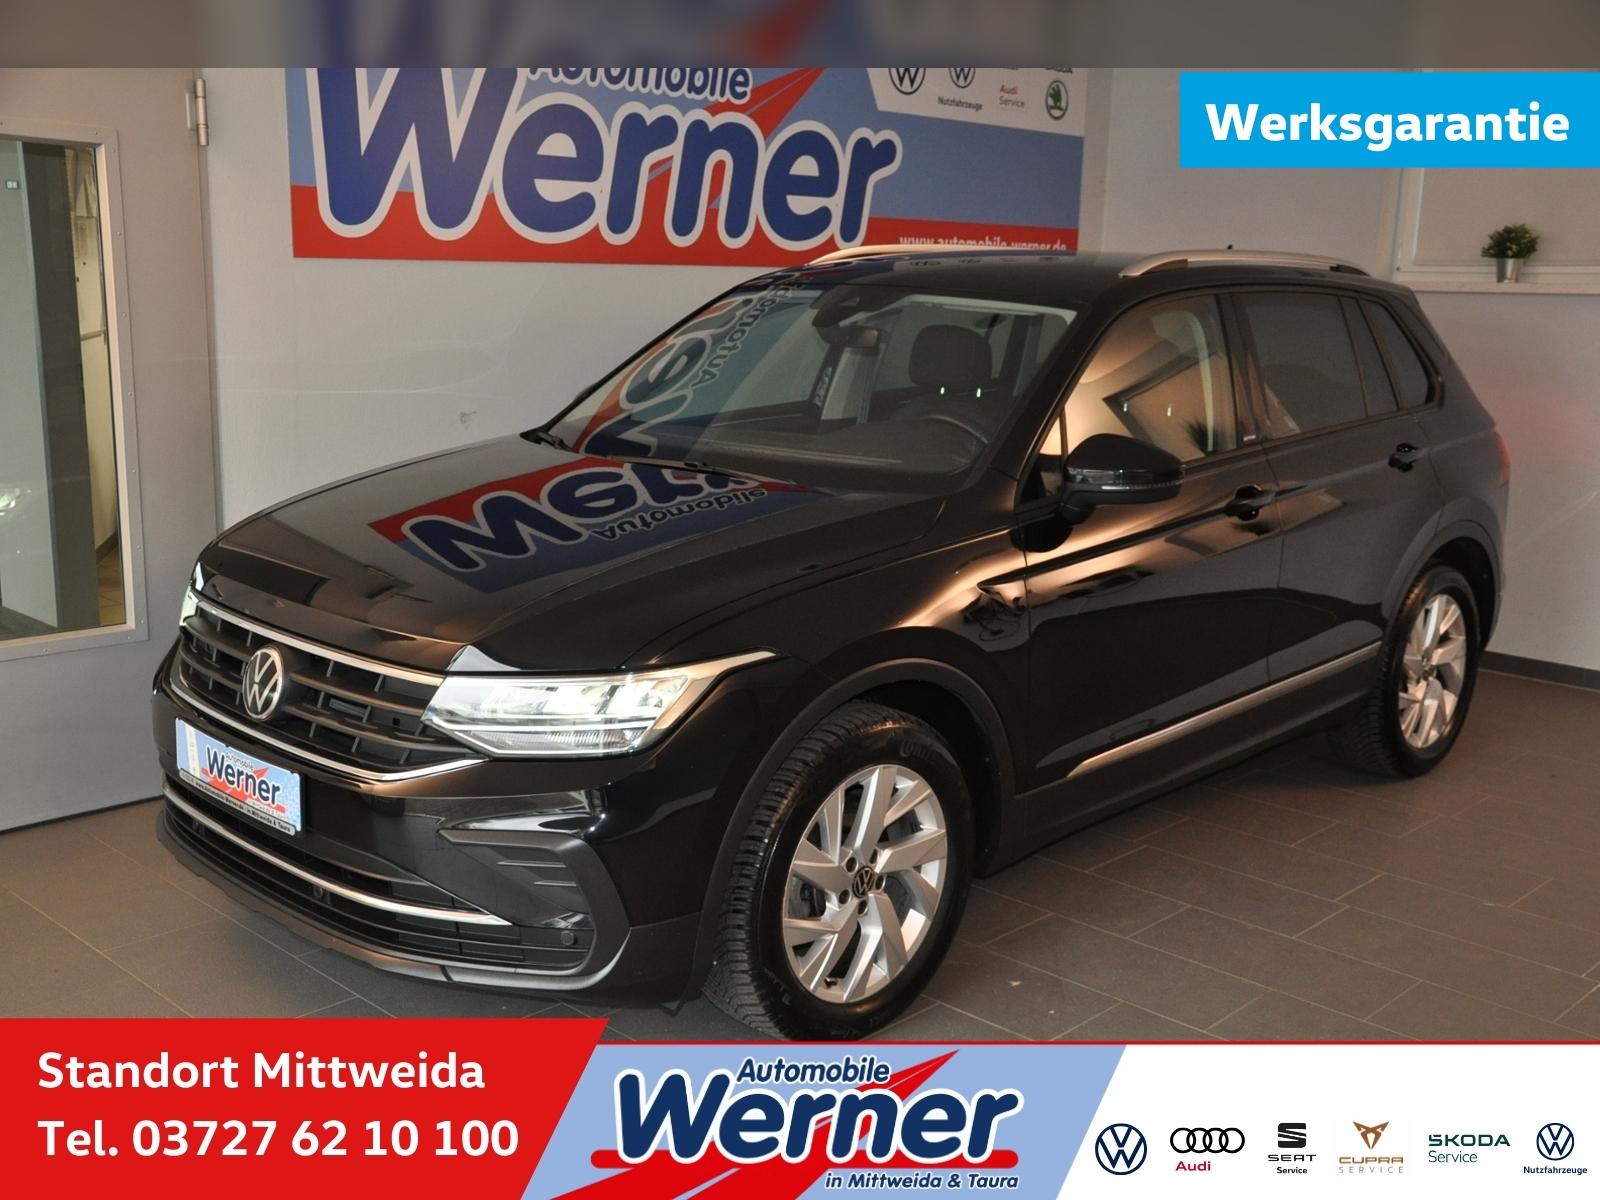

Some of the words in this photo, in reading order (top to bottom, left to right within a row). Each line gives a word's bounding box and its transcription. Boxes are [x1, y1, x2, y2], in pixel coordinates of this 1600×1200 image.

[1000, 84, 1018, 95] Audi
[938, 96, 983, 111] Nutzfahrzeuge
[999, 95, 1025, 109] Service
[317, 68, 897, 243] Werner
[206, 747, 281, 805] Werner
